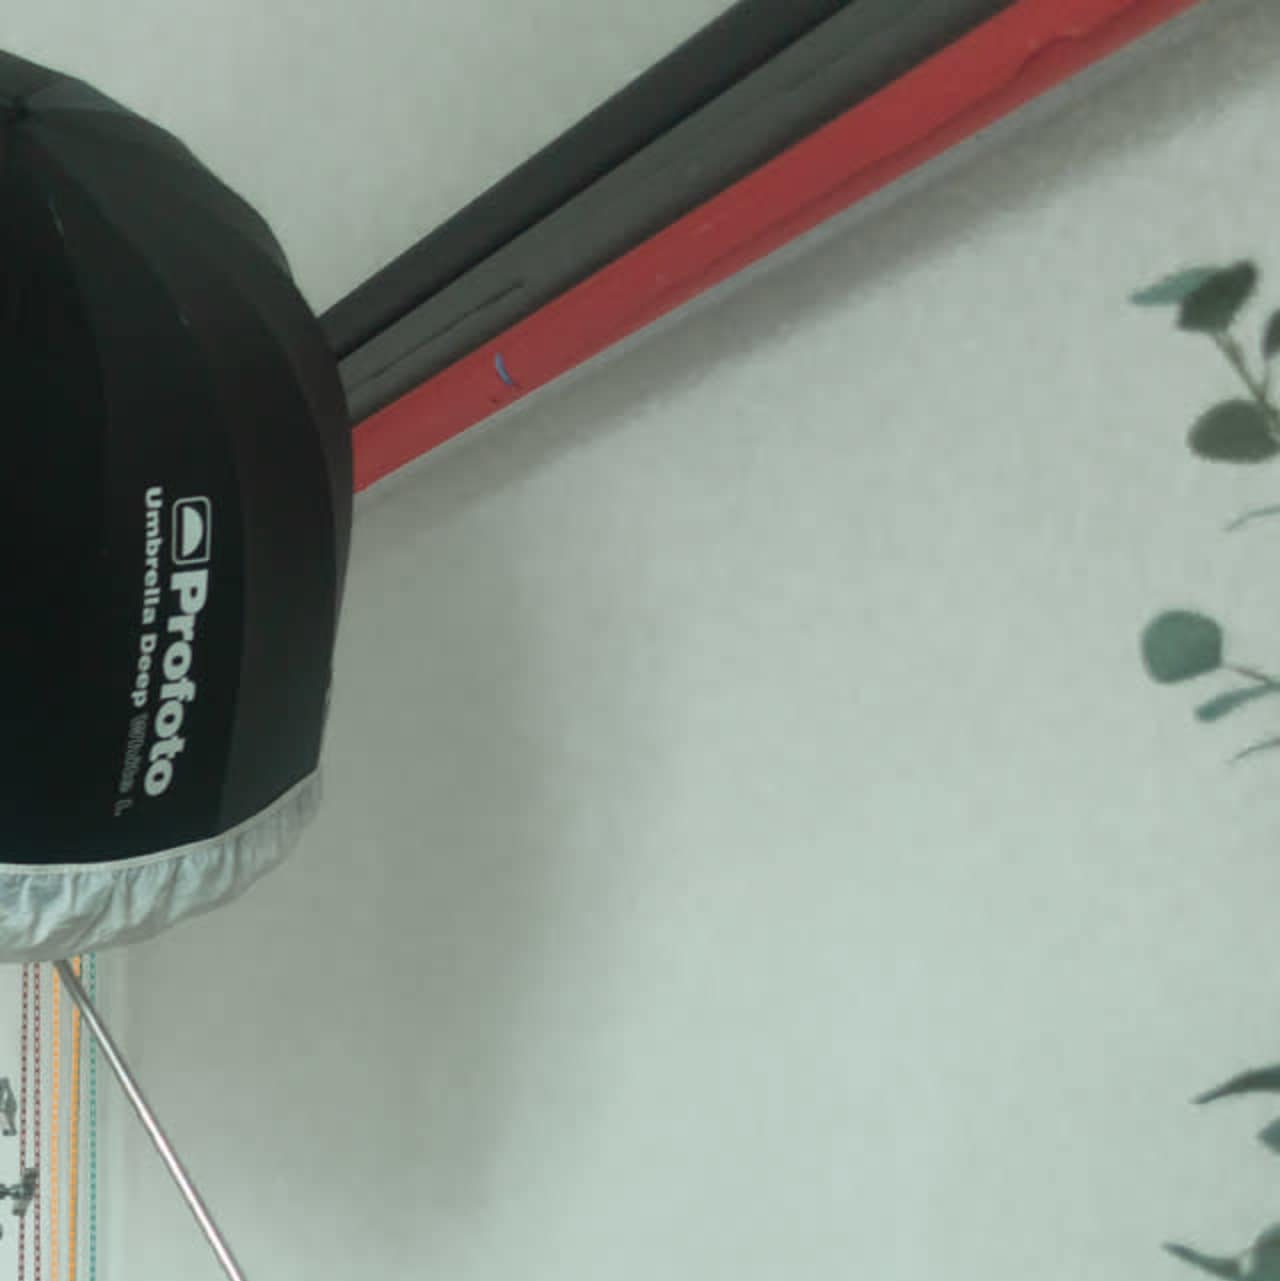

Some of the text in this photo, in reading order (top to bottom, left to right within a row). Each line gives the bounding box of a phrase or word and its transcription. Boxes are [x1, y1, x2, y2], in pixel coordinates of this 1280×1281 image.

[143, 487, 163, 624] Umbrella
[131, 633, 157, 708] Deep
[144, 569, 209, 797] Profoto
